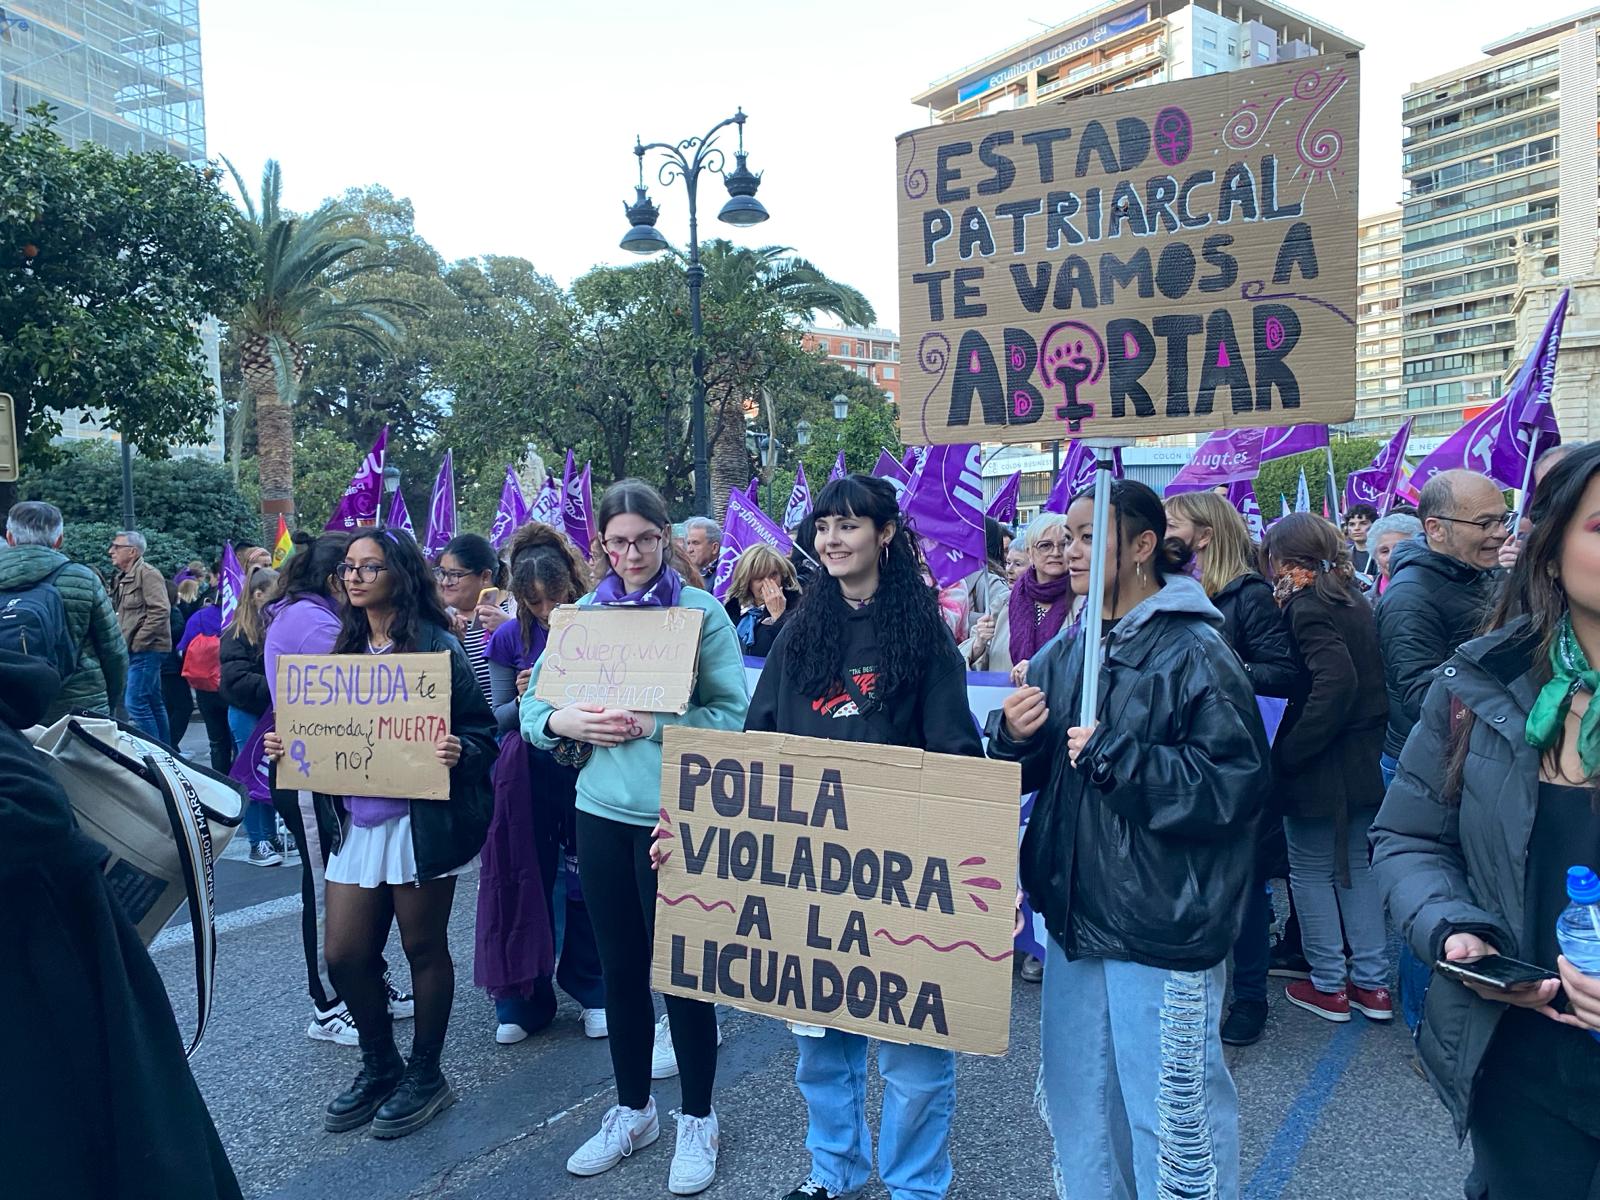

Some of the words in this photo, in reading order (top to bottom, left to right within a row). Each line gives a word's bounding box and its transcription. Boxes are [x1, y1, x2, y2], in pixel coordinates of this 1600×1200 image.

[989, 56, 1043, 88] equilibrio
[1045, 36, 1089, 67] urbano
[936, 106, 1193, 205] ESTADO
[922, 153, 1305, 267] PATRIARCAL
[912, 267, 988, 322] TE
[1009, 233, 1239, 314] VAMOS
[1272, 222, 1320, 285] A
[946, 303, 1303, 431] ABORTAR
[286, 663, 409, 706] DESNUDA
[415, 670, 437, 699] te
[598, 661, 627, 685] NO
[335, 746, 374, 780] no?
[678, 753, 849, 831] POLLA
[186, 789, 208, 830] MARC
[678, 821, 956, 915] VIOLADORA
[736, 894, 772, 941] A
[806, 904, 872, 957] LA
[670, 933, 949, 1037] LICUADORA
